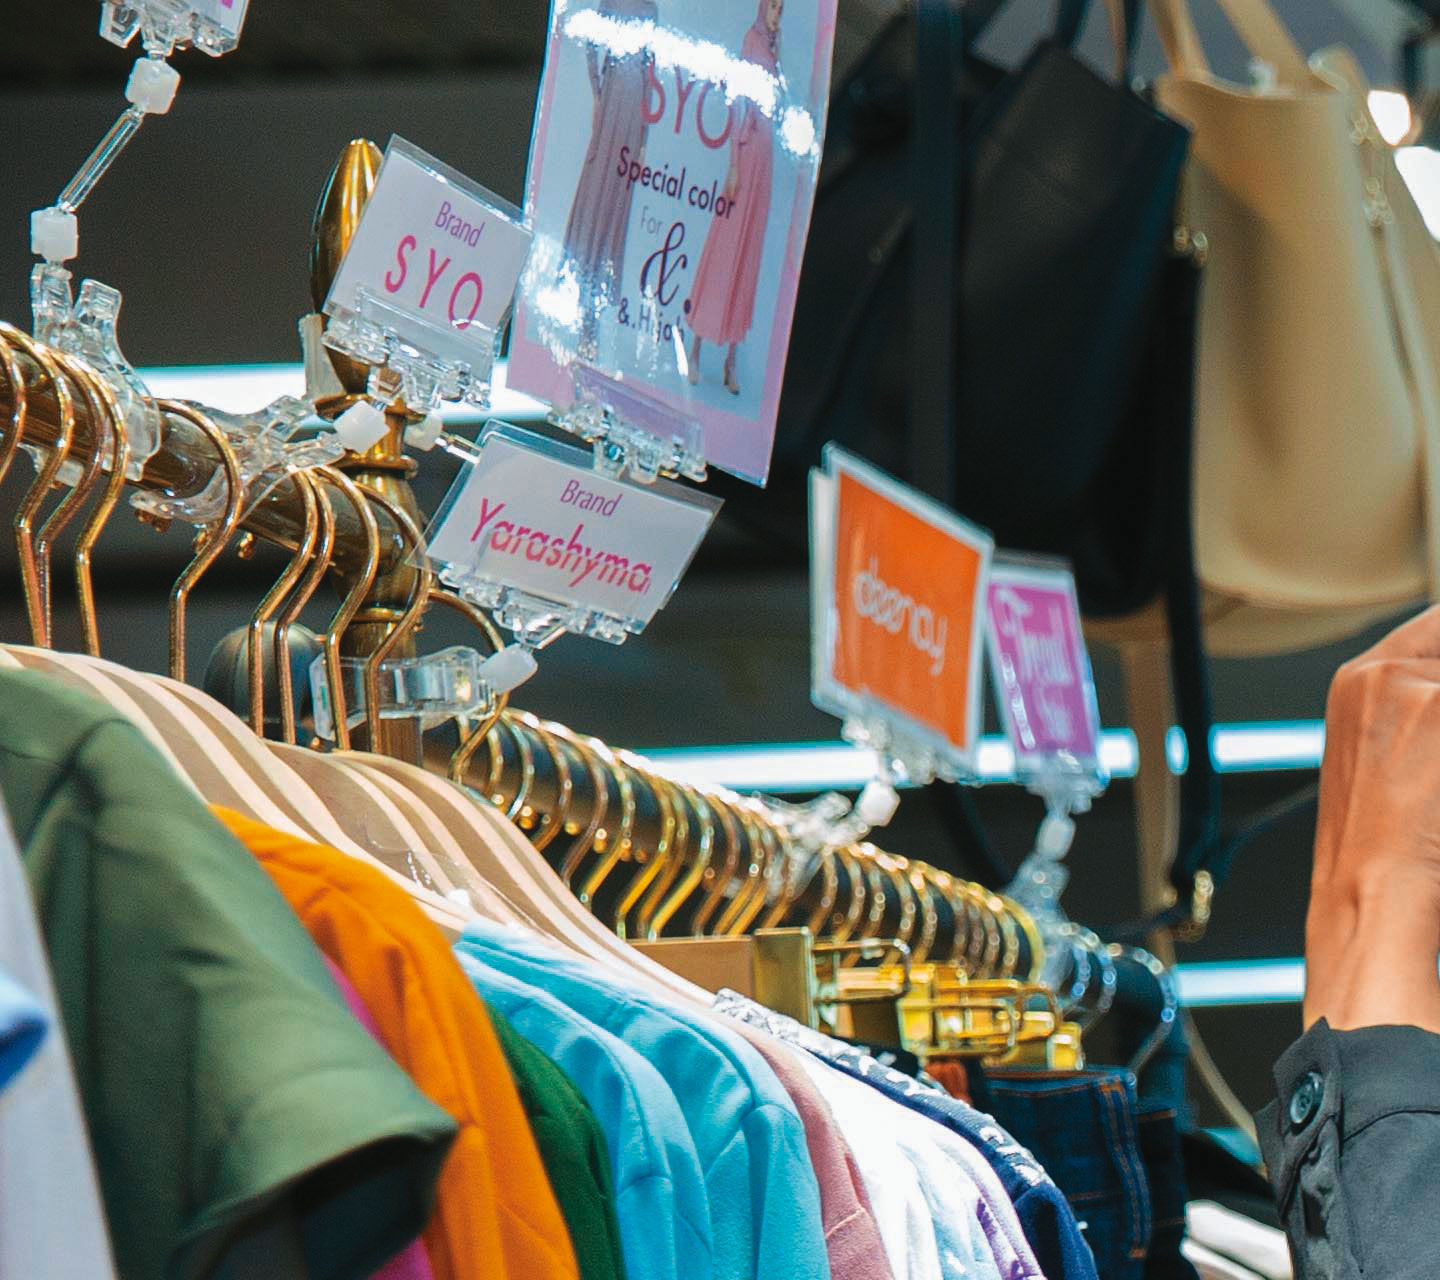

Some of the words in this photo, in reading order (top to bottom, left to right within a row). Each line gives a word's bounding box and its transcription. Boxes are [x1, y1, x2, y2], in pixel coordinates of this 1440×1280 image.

[617, 146, 686, 200] Special
[688, 180, 735, 219] color
[435, 201, 486, 248] Brand
[640, 206, 665, 235] For
[384, 235, 483, 330] SYO
[560, 479, 623, 517] Brand
[470, 497, 653, 594] Yarashyma
